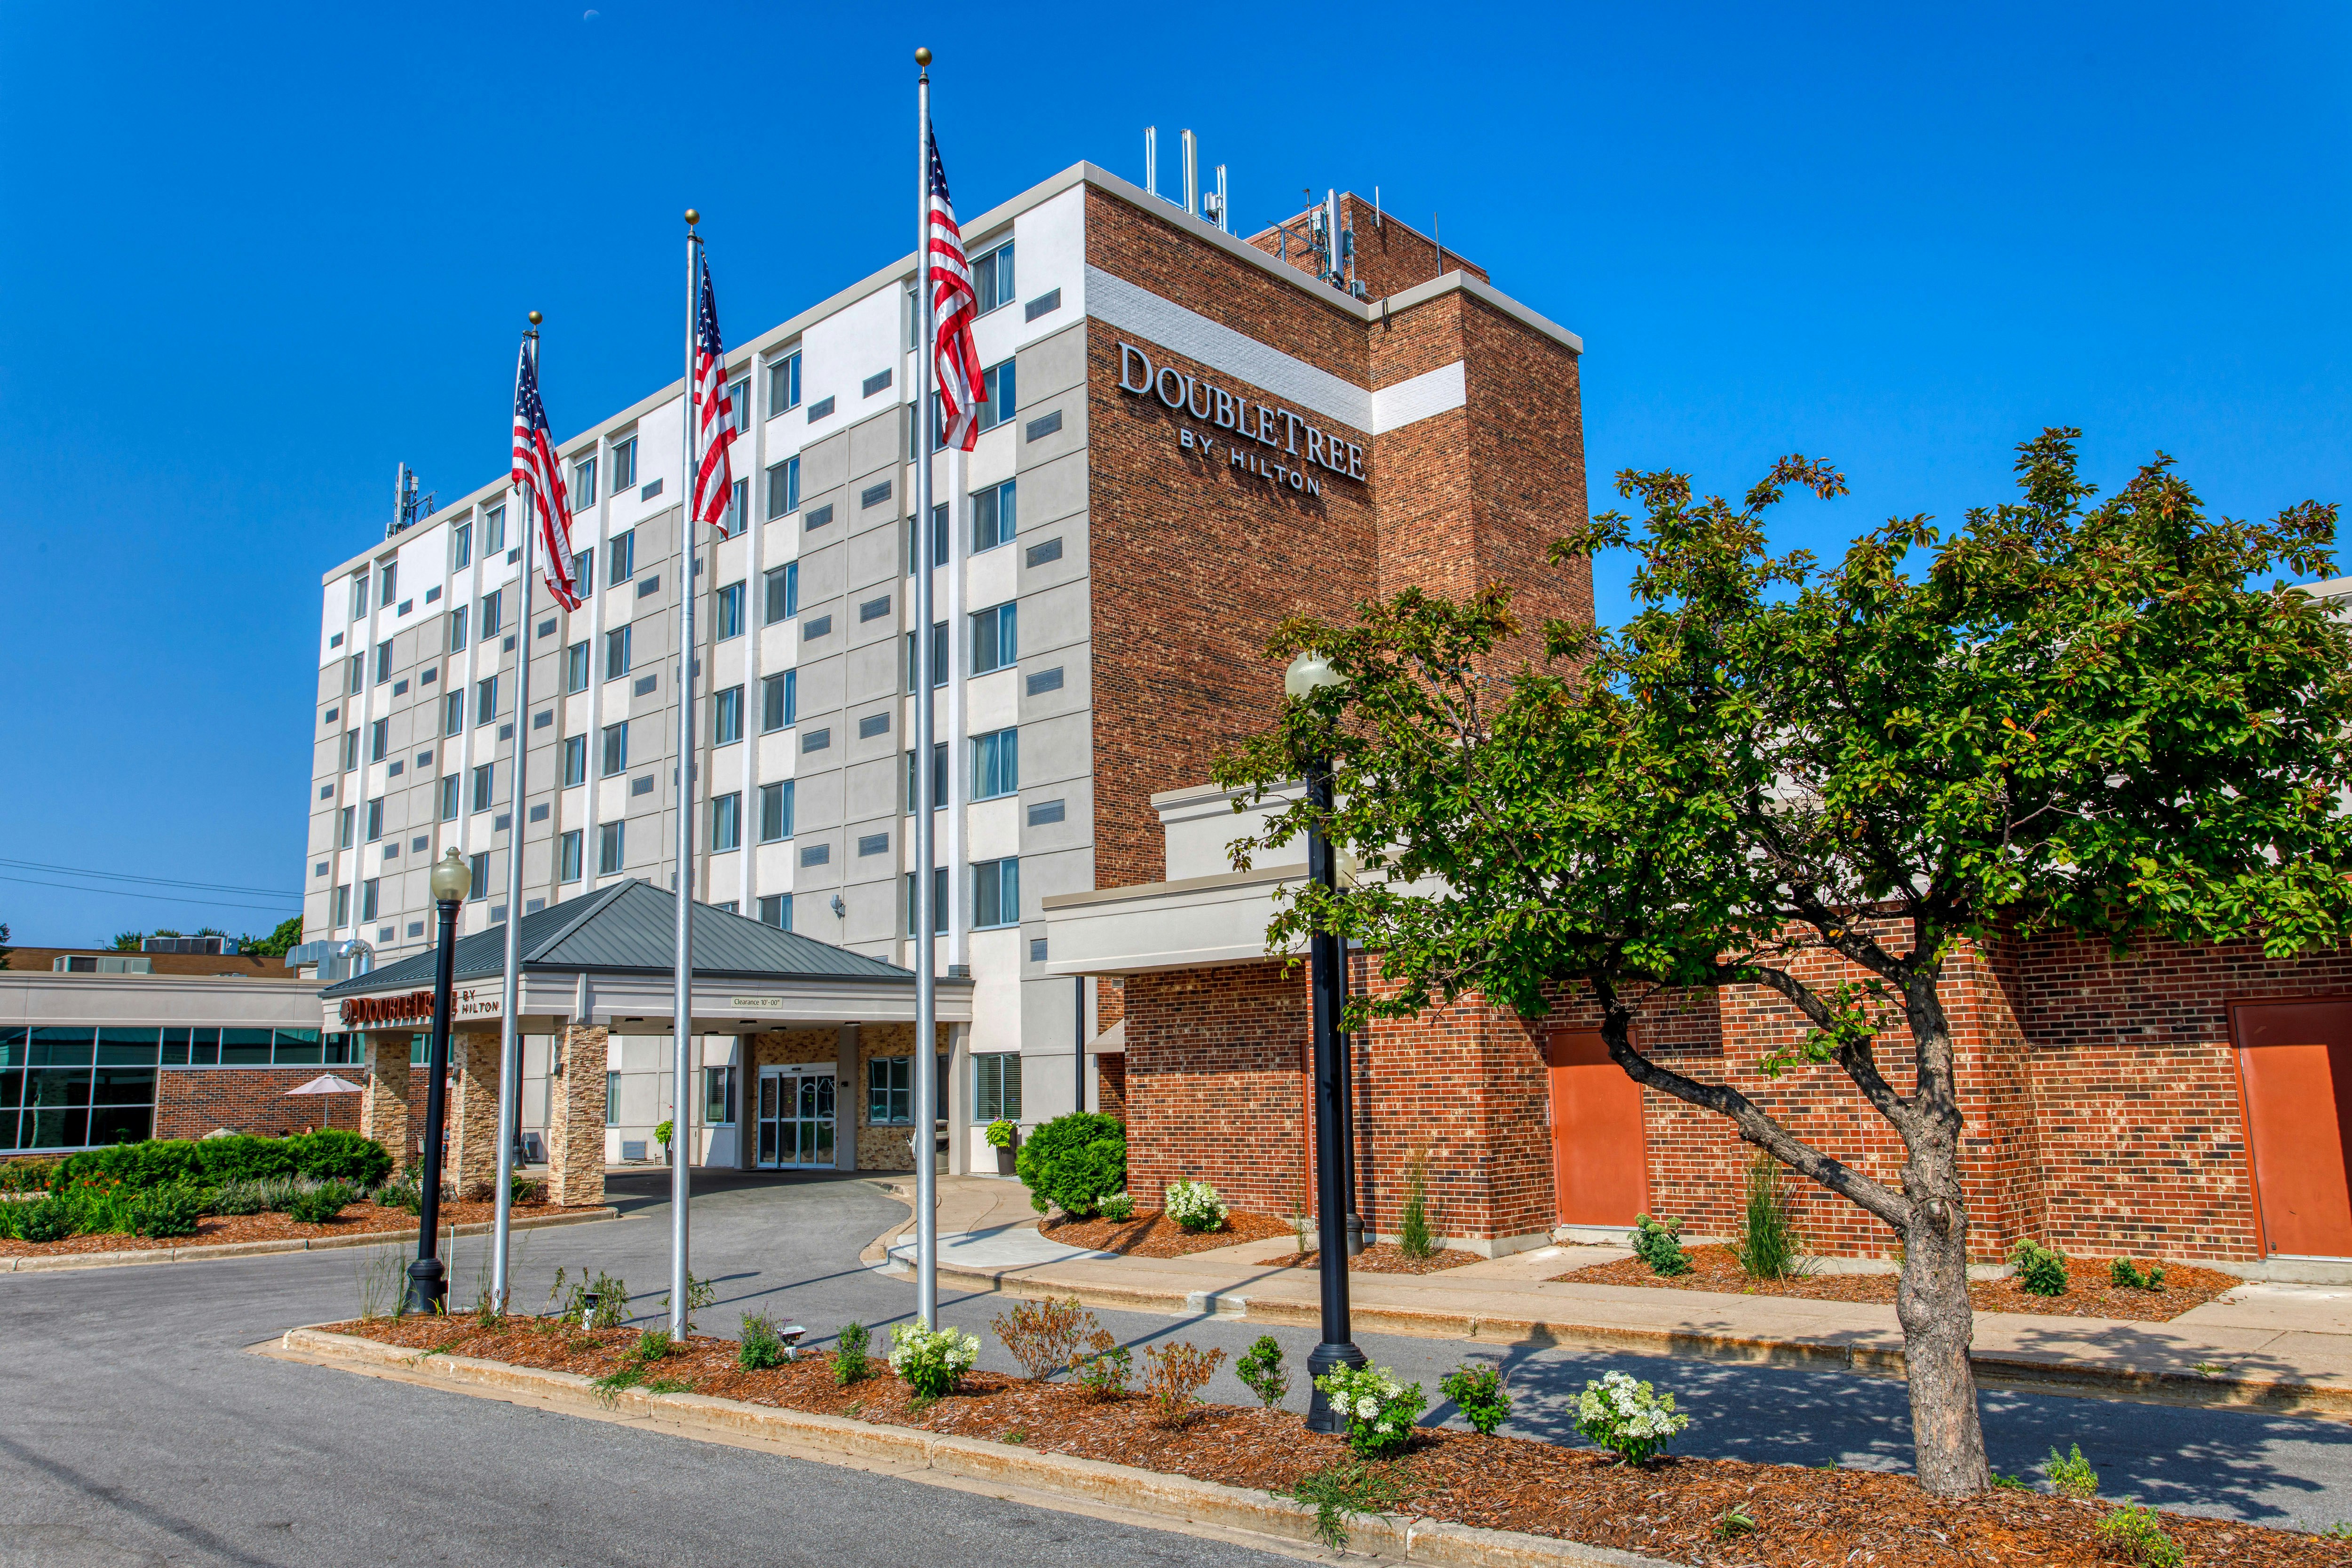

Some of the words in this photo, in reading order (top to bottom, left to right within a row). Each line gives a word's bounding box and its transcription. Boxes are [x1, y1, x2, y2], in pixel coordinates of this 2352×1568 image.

[1118, 341, 1365, 482] DOUBLETREE
[1179, 428, 1213, 454] BY
[1230, 447, 1319, 496] HILTON
[358, 991, 458, 1023] DOUBLETR
[462, 1001, 499, 1014] HILTON
[463, 990, 476, 1001] BY
